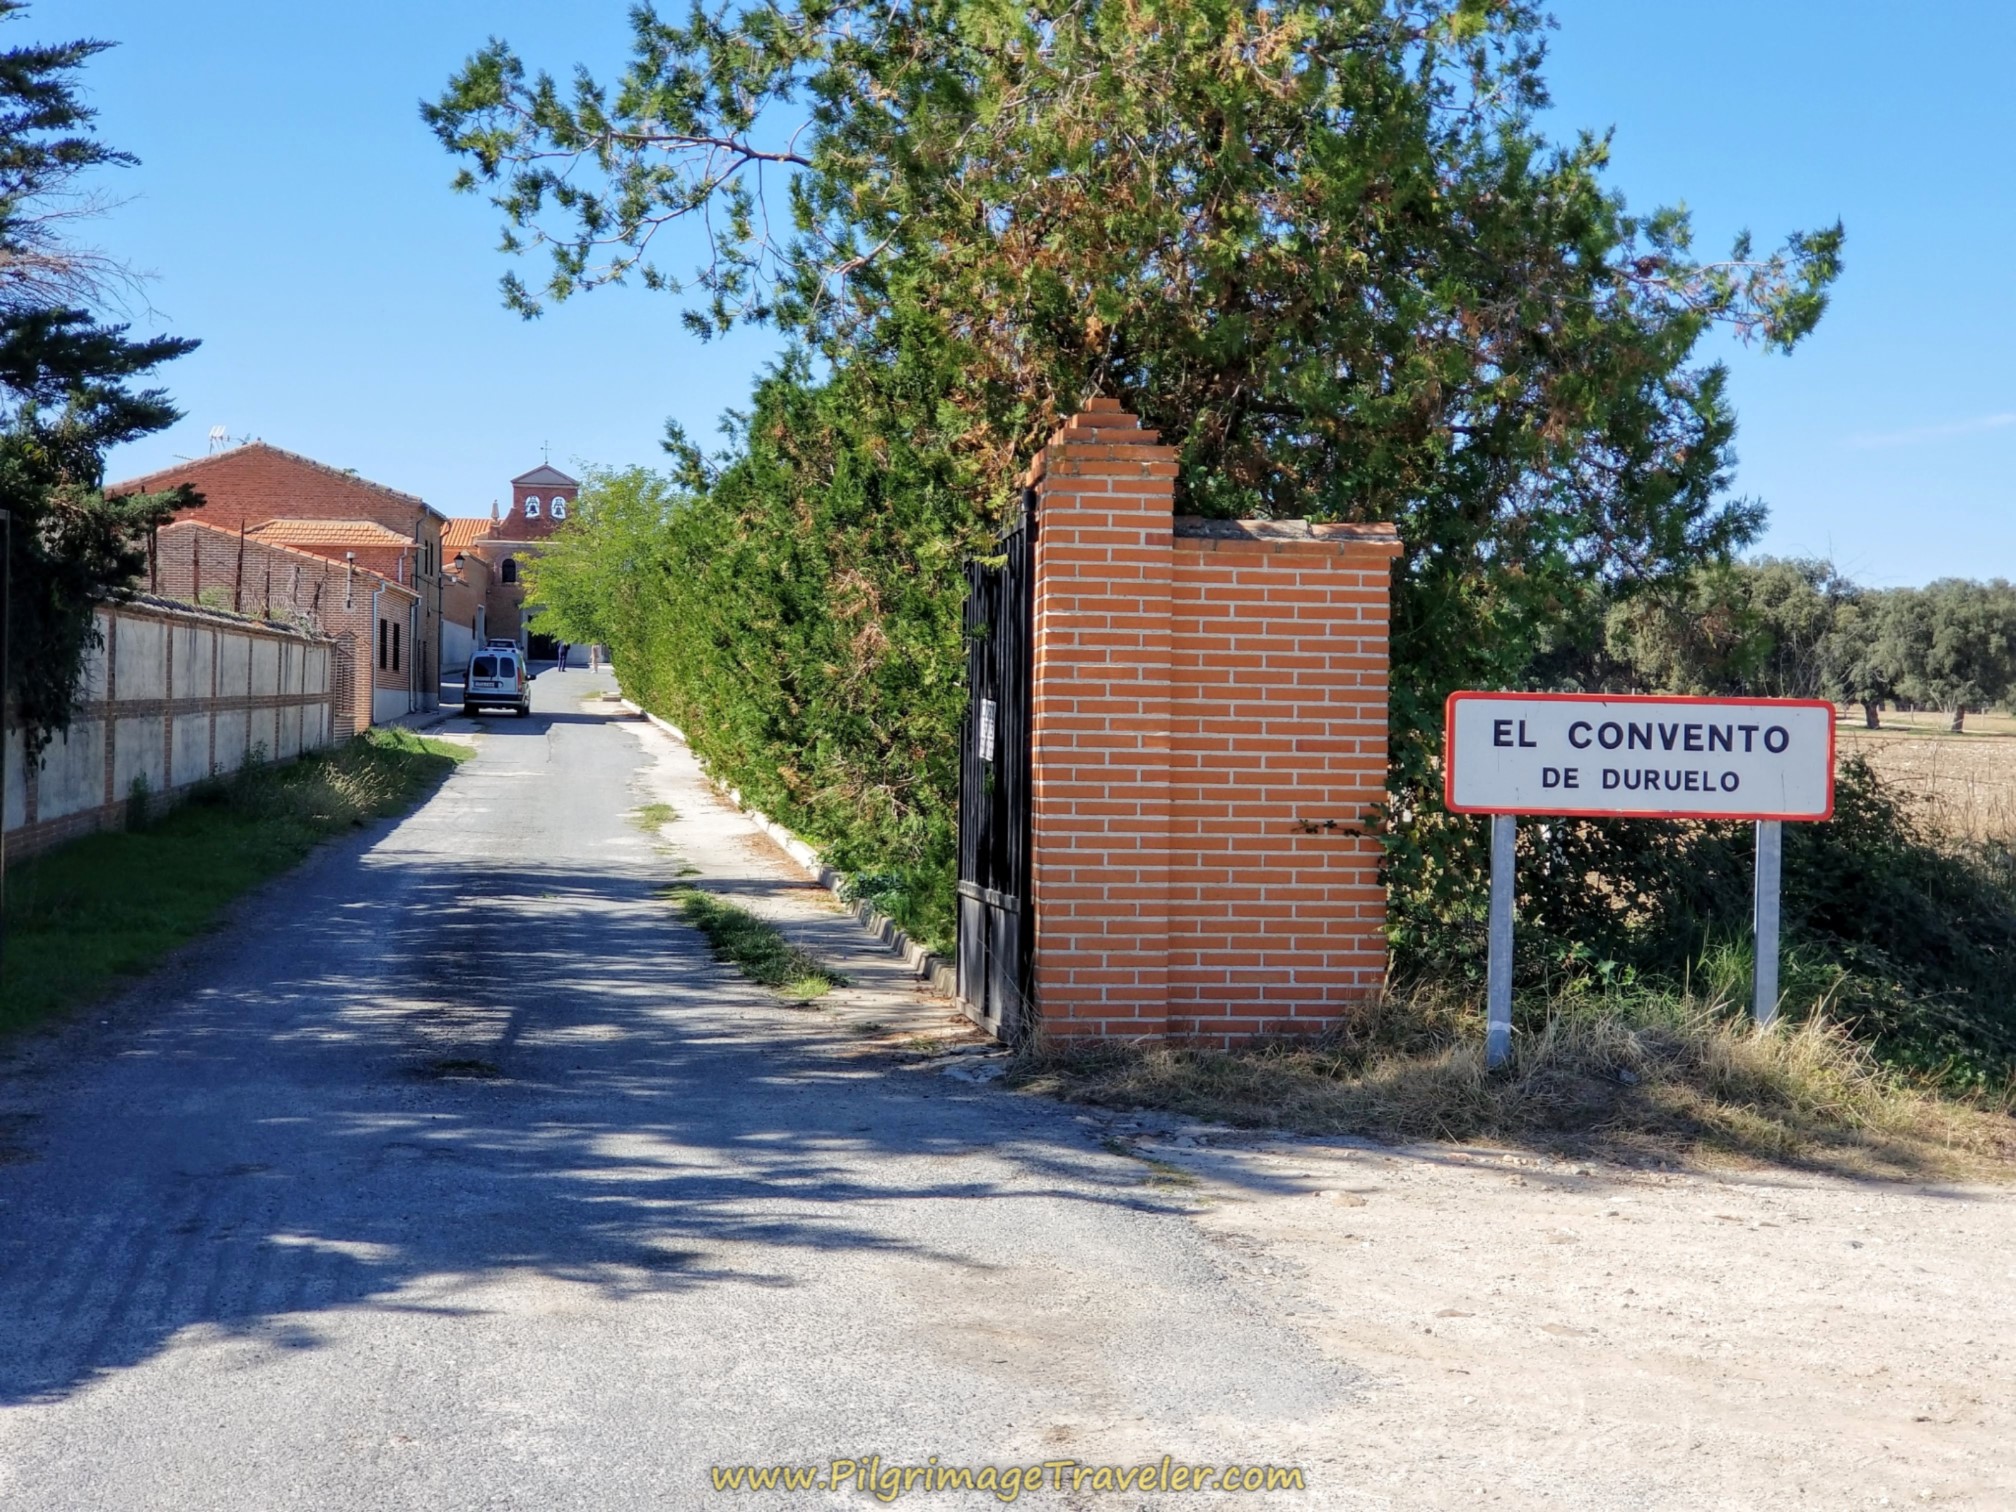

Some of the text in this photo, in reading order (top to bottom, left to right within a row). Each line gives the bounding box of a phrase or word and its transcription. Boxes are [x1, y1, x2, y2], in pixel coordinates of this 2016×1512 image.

[1493, 719, 1790, 754] EL CONVENTO
[1542, 767, 1740, 793] DE DURUELO
